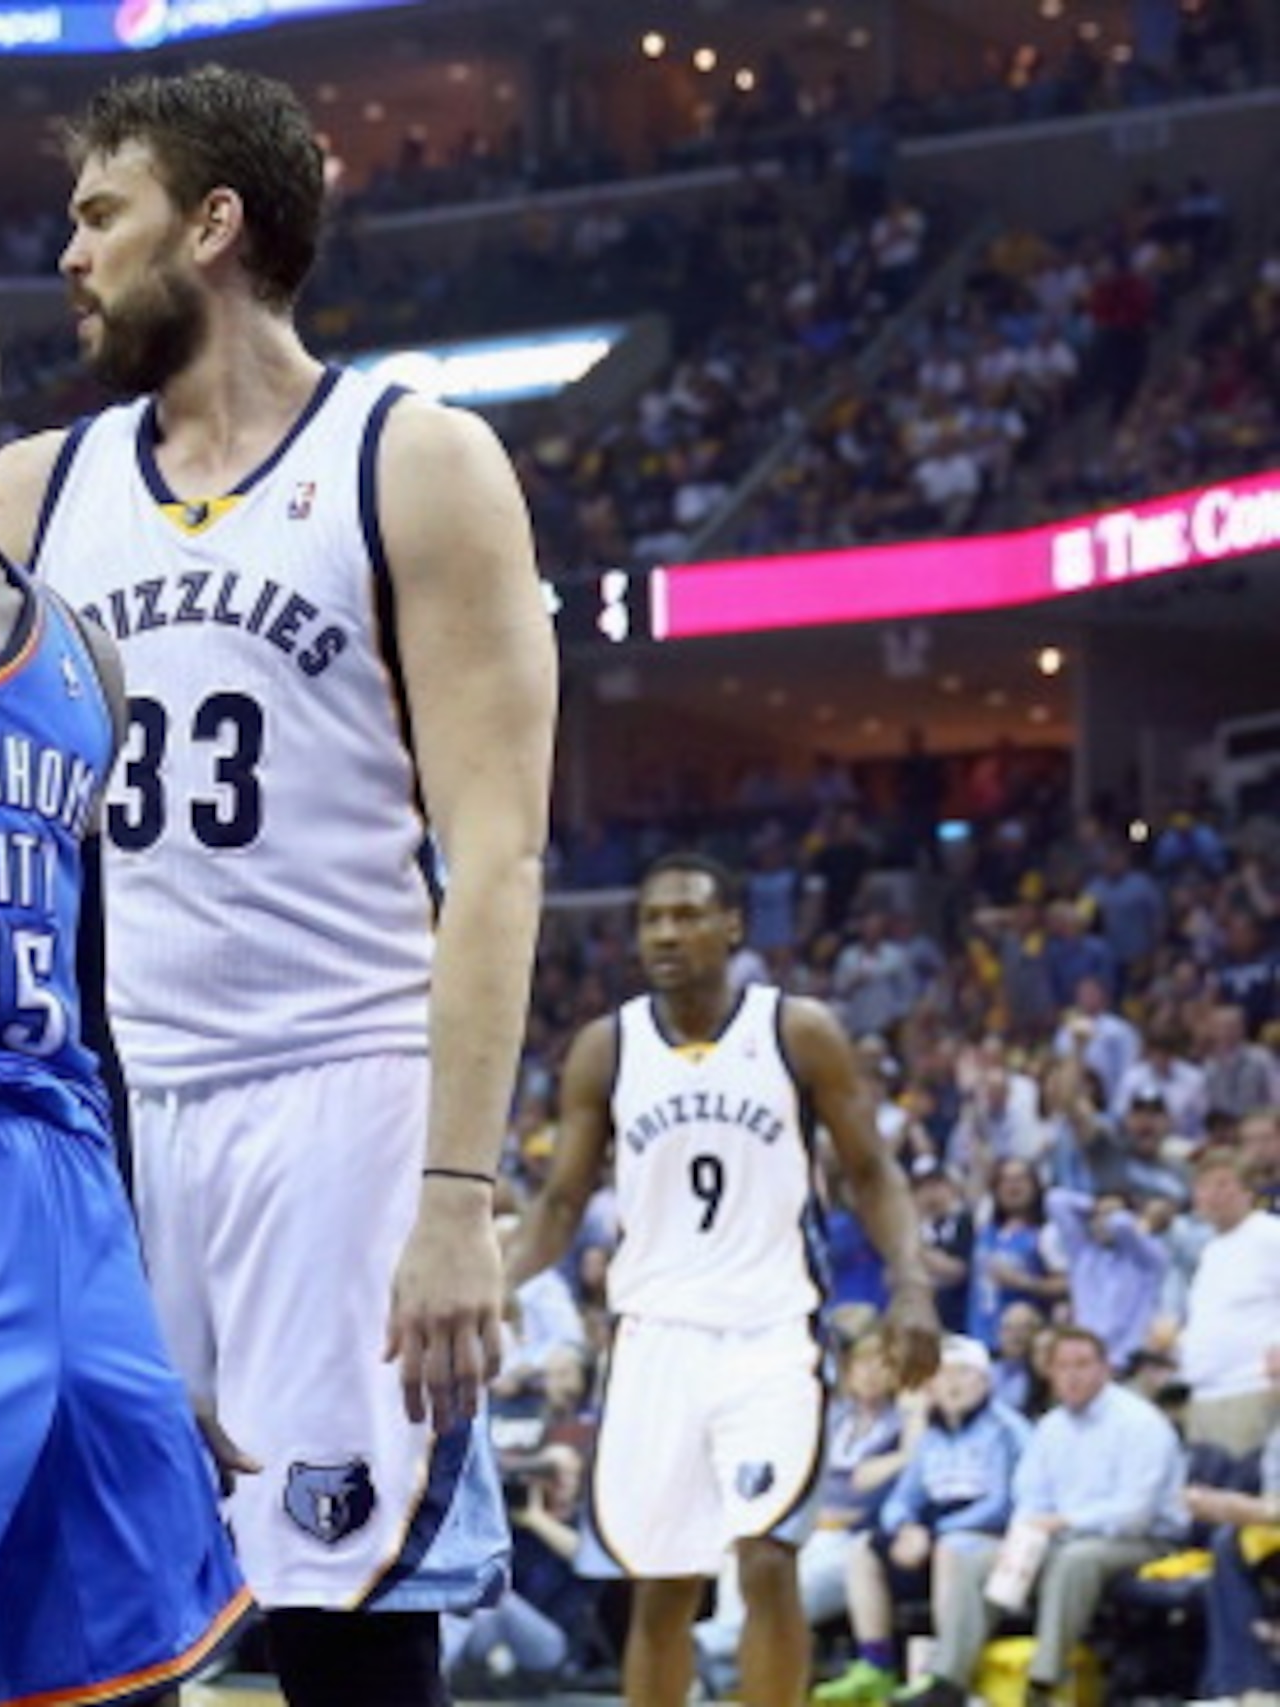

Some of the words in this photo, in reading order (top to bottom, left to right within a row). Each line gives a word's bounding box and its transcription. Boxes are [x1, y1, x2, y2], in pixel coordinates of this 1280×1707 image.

[81, 570, 348, 678] IZZLIES
[106, 691, 266, 852] 33
[625, 1091, 785, 1156] GRIZZLIES
[690, 1153, 726, 1234] 9
